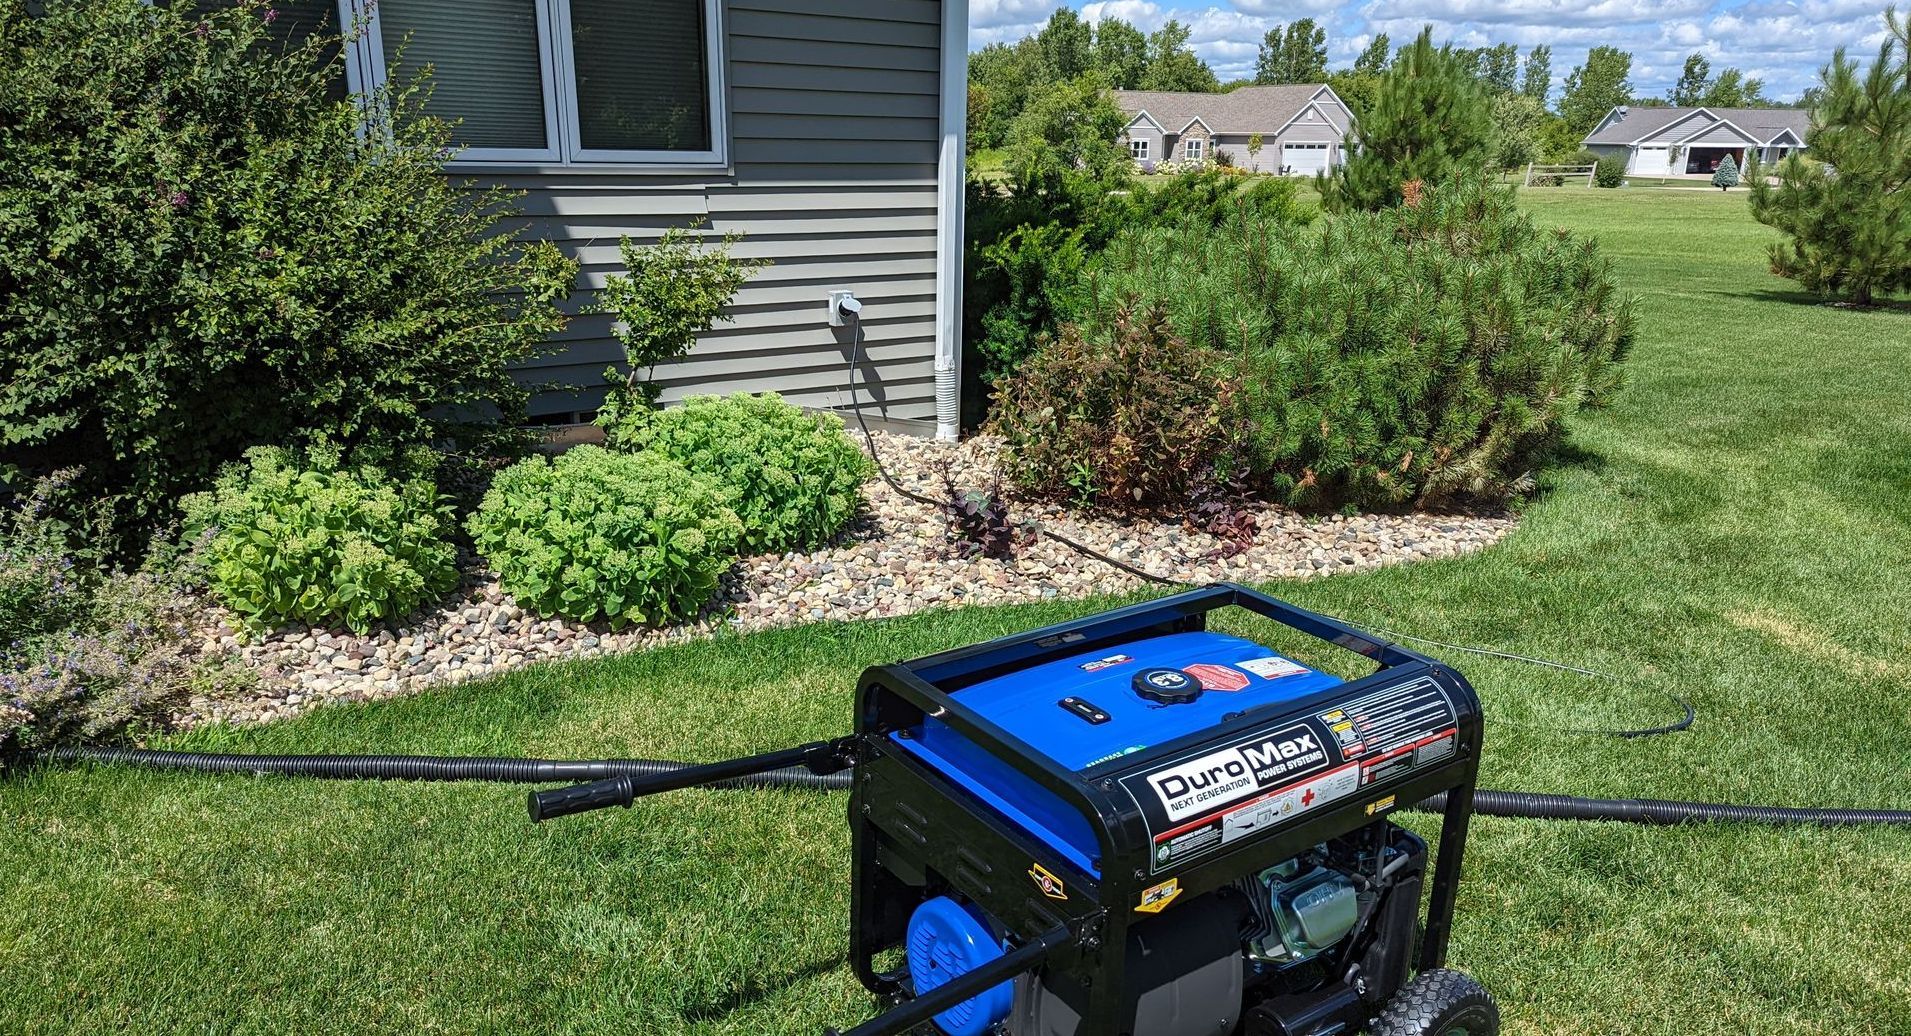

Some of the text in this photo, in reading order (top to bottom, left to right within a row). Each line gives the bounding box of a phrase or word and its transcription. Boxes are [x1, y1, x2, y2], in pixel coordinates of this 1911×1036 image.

[1256, 764, 1287, 781] POWER
[1287, 750, 1323, 770] SYSTEMS
[1170, 797, 1194, 812] NEXT
[1197, 776, 1251, 803] GENERATION
